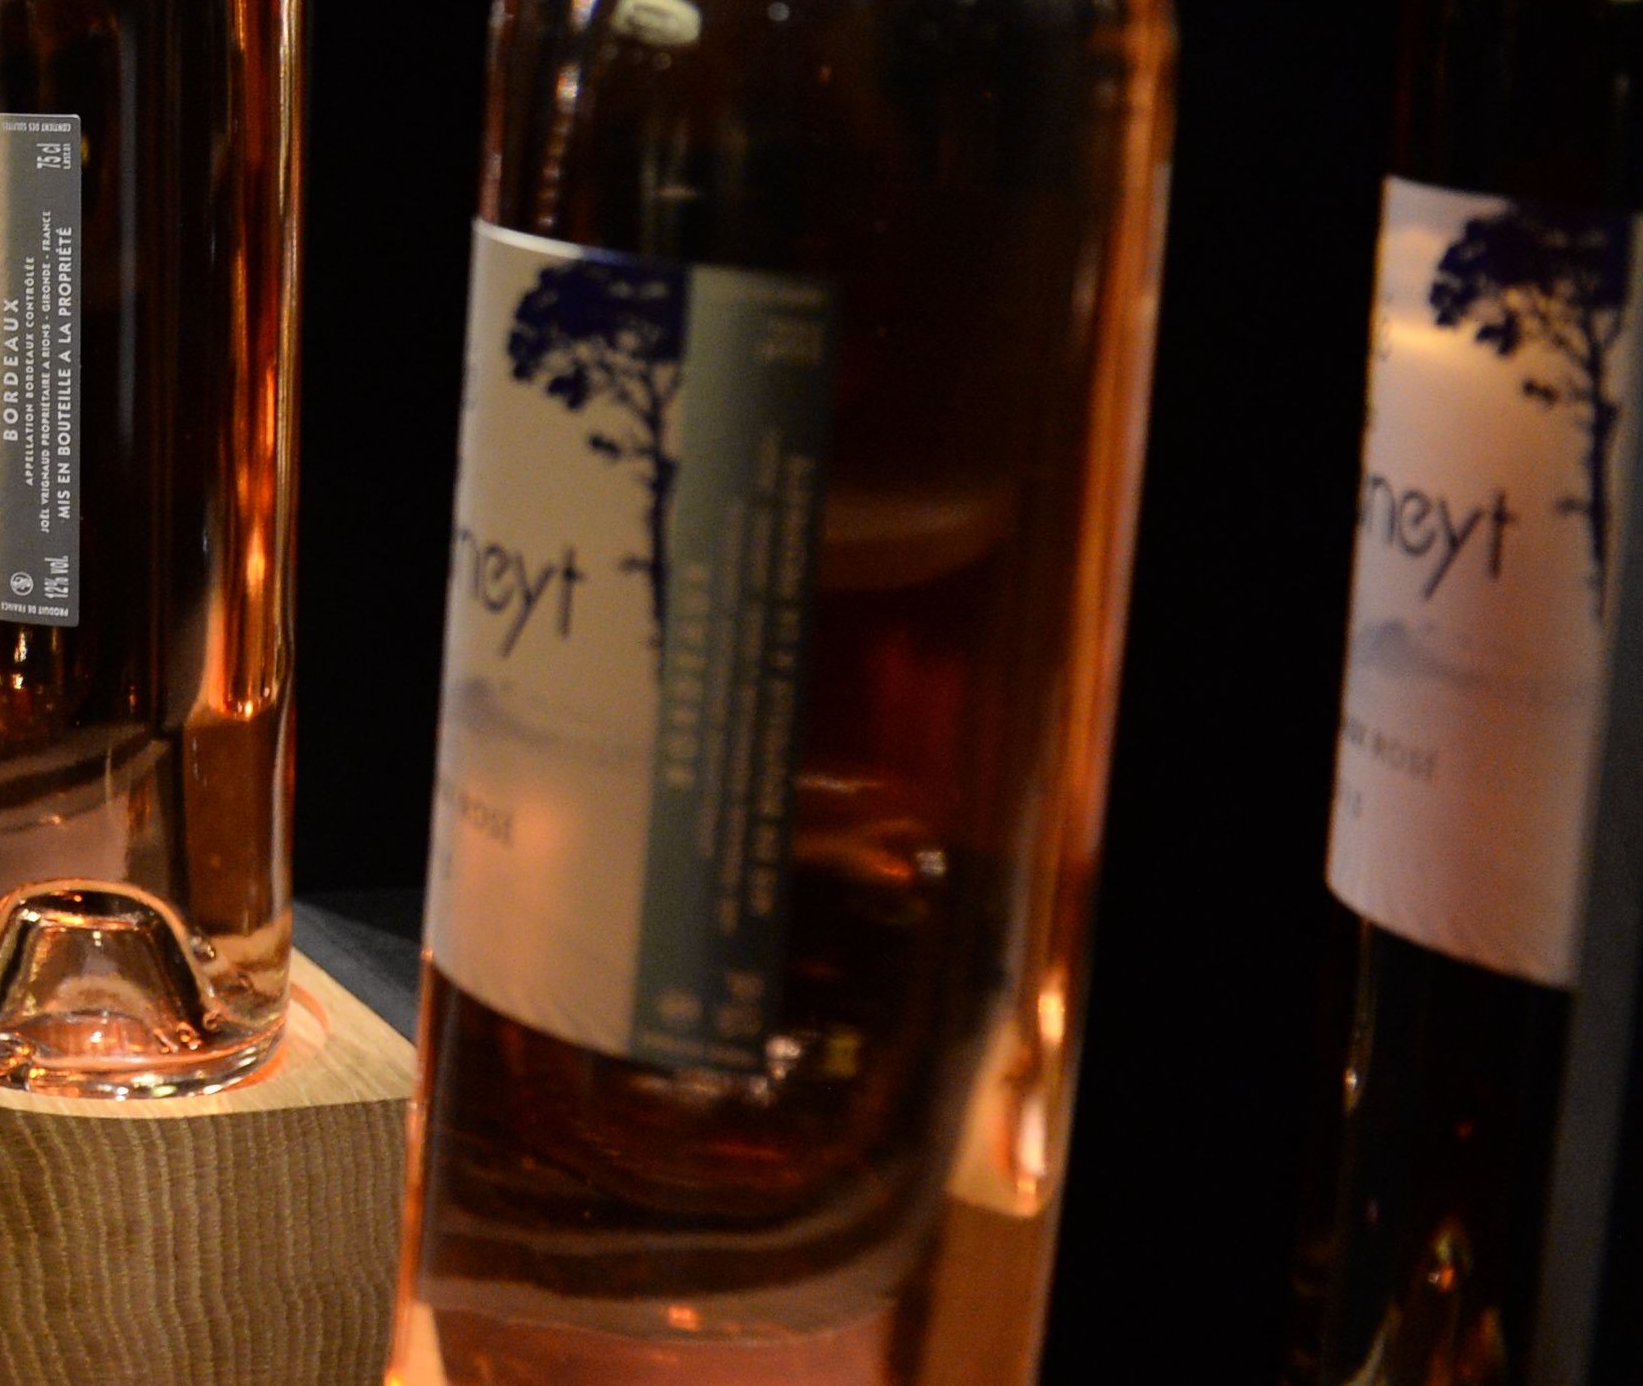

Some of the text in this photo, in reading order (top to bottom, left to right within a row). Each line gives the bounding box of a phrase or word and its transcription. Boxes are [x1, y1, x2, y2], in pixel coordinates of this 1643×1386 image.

[36, 142, 62, 169] 75 cl
[42, 211, 51, 251] FRANCE
[41, 263, 51, 312] GIRONDE
[41, 324, 50, 357] RIONS
[3, 298, 19, 442] BORDEAUX
[23, 256, 35, 486] APPELLATION BORDEAUX CONTRÔLÉE
[56, 227, 71, 519] MIS EN BOUTEILLE A LA PROPRIÉTÉ
[41, 449, 50, 504] VRIGNAUD
[43, 577, 69, 599] 12%
